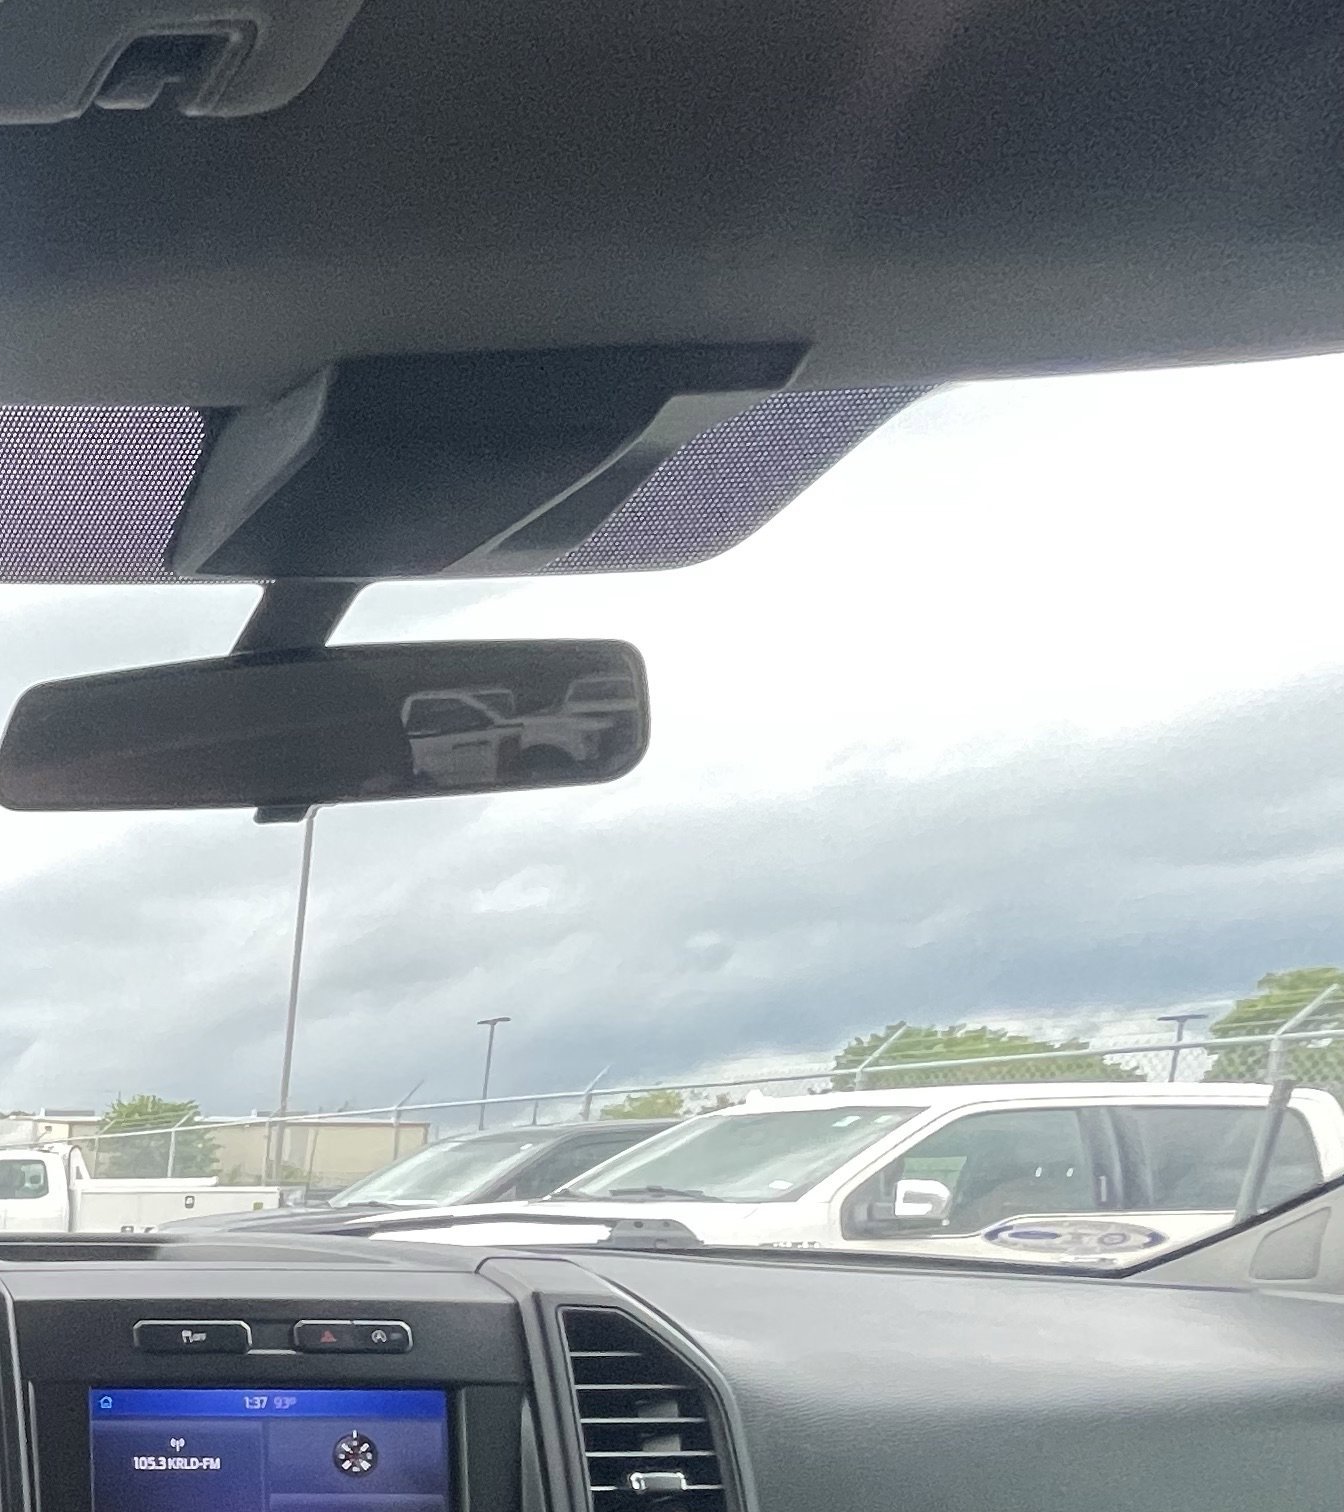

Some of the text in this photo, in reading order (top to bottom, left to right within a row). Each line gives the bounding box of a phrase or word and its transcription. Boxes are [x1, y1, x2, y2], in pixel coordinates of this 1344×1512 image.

[244, 1396, 268, 1409] 1:37
[133, 1456, 221, 1470] 105.3 KRLD-FM
